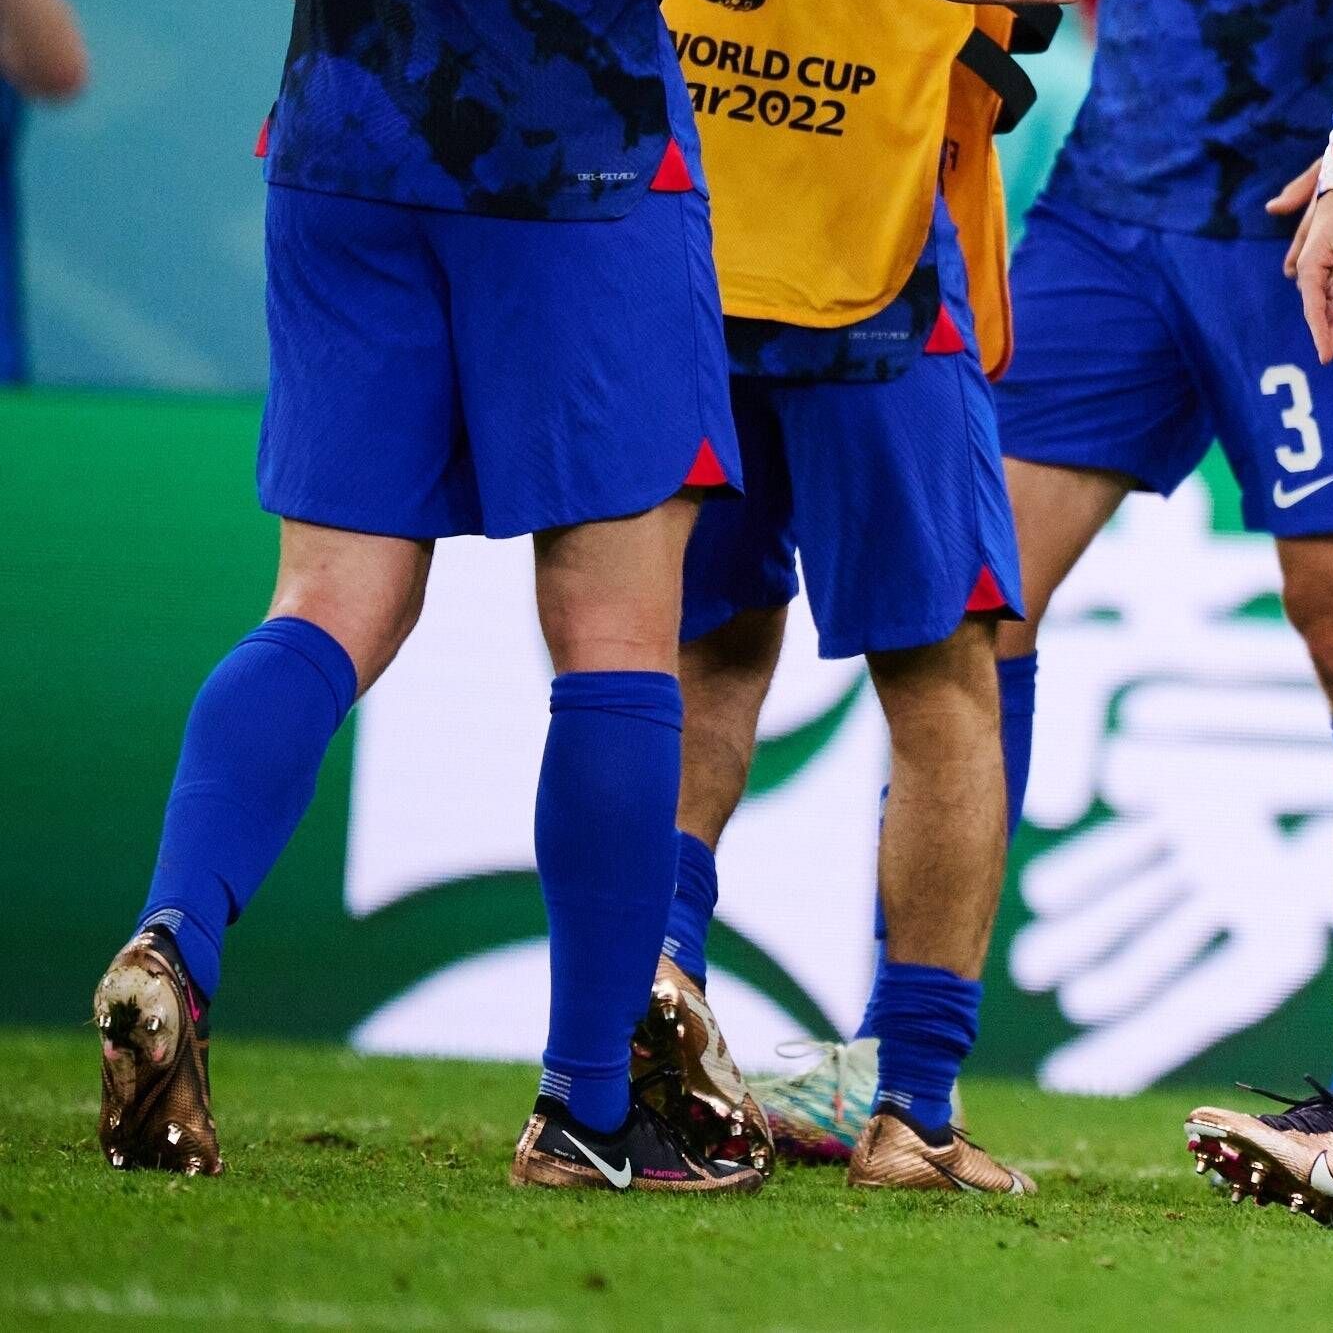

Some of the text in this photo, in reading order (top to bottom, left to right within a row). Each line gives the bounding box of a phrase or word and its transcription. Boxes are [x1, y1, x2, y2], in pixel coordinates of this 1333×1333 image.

[797, 57, 876, 95] CUP
[686, 82, 846, 137] ar2022
[1261, 365, 1323, 473] 3
